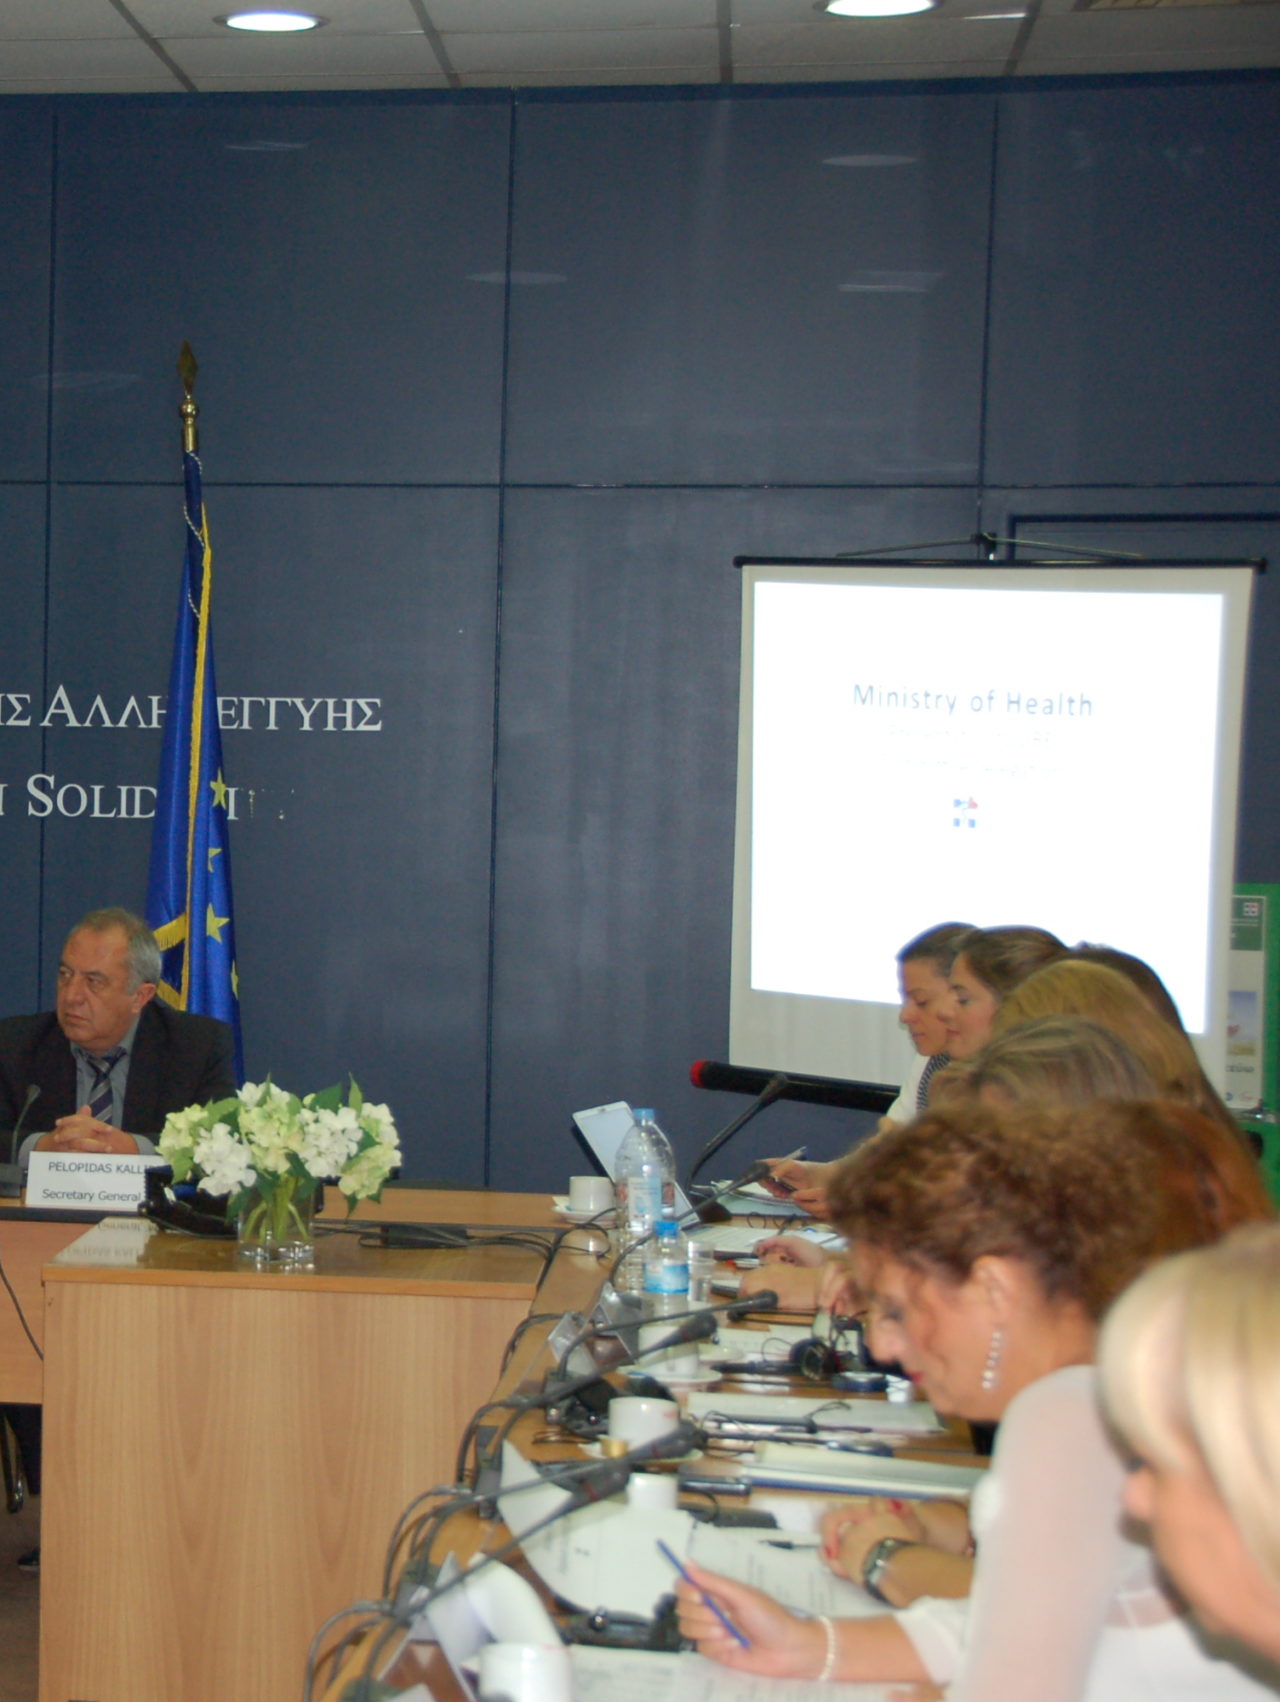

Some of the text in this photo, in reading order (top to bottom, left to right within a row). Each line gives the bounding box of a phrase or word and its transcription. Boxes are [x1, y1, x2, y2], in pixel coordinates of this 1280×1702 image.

[40, 684, 382, 731] ΑΛΛΗΕΓΓΥΗΣ
[852, 684, 1093, 716] Ministry of Health
[48, 1161, 113, 1174] PELOPIDAS
[42, 1188, 141, 1201] Secretary General
